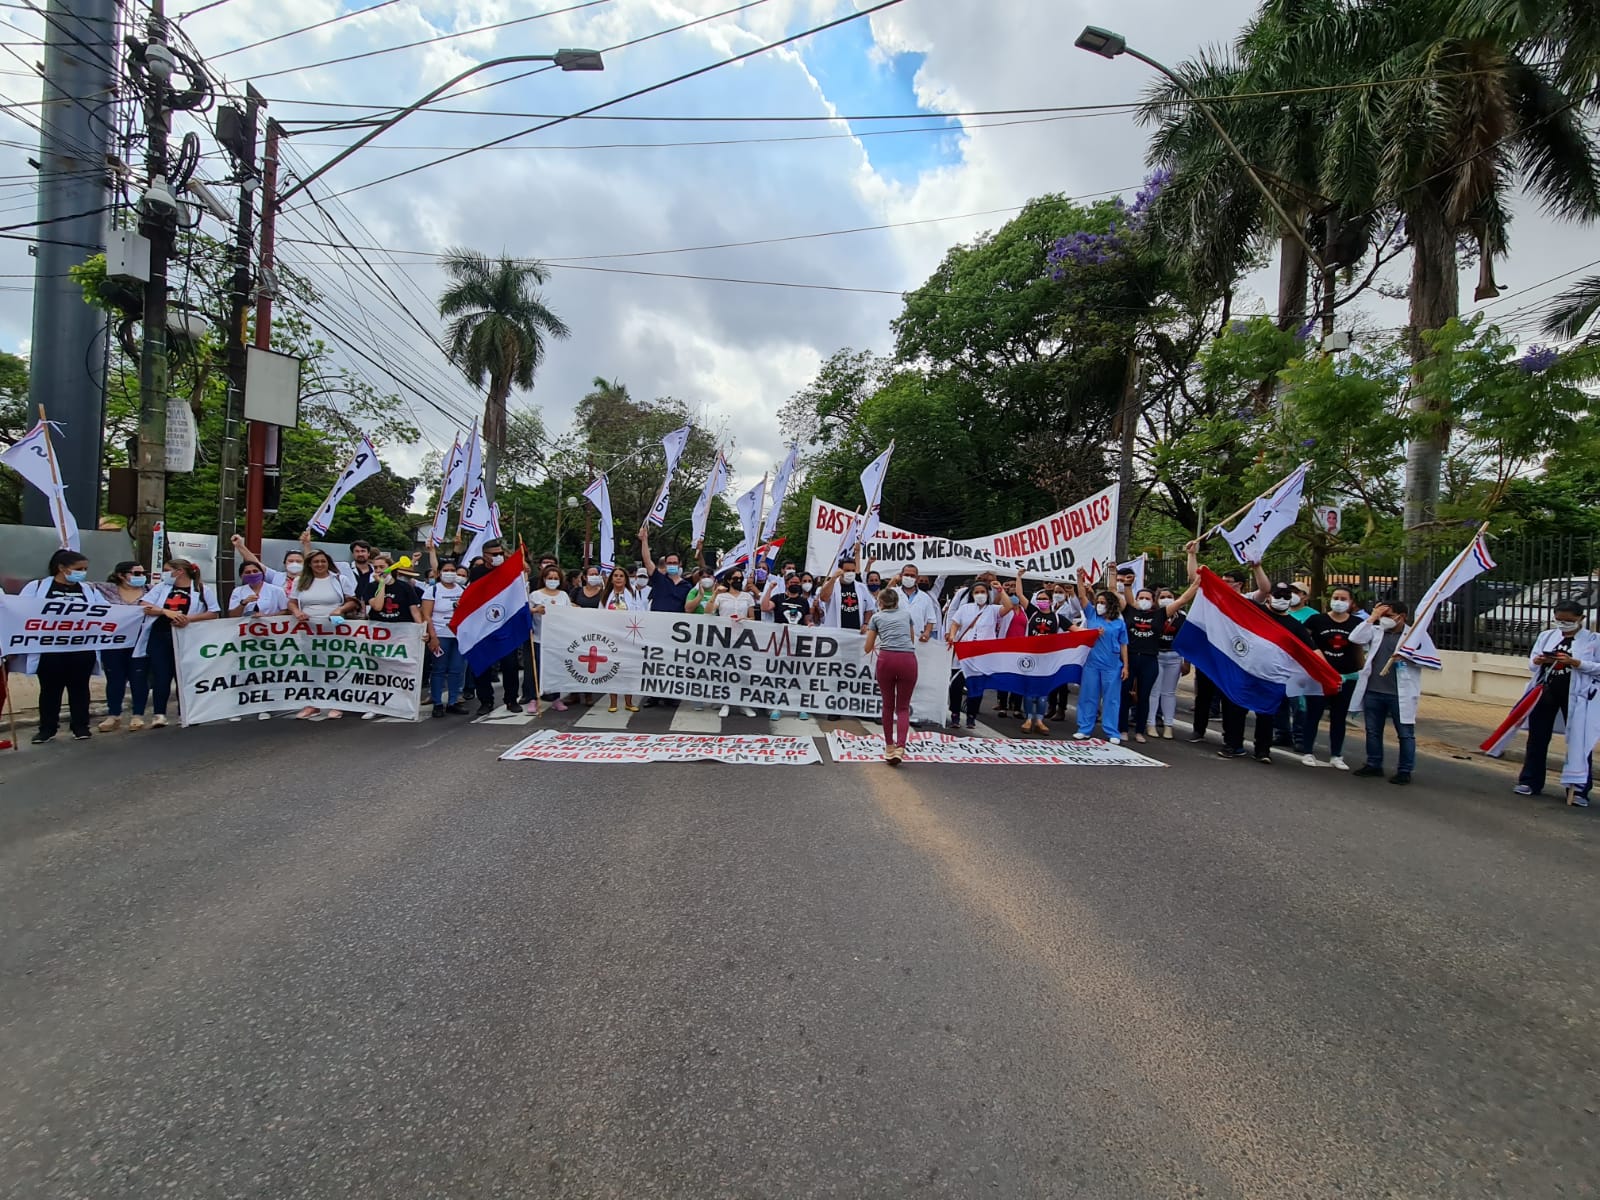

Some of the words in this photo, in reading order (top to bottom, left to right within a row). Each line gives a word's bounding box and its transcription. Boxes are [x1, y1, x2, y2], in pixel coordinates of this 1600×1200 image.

[816, 505, 861, 535] BAST
[994, 524, 1050, 558] DINERO
[1050, 494, 1110, 546] PÚBLICO
[860, 541, 916, 561] IGIMOS
[922, 539, 992, 563] MEJORAS
[995, 559, 1011, 569] EN
[1015, 547, 1075, 572] SALUD
[41, 602, 112, 617] APS
[25, 619, 117, 632] Guaira
[238, 621, 392, 641] IGUALDAD
[200, 637, 299, 659] CARGA
[313, 638, 409, 659] HORARIA
[567, 639, 580, 654] CHE
[671, 621, 839, 658] SINAMED
[239, 653, 379, 671] IGUALDAD
[564, 659, 589, 684] SINAMED
[641, 645, 664, 660] 12
[674, 648, 752, 671] HORAS
[765, 658, 877, 680] UNIVERSA
[195, 670, 314, 694] SALARIAL
[642, 661, 741, 683] NECESARIO
[750, 674, 801, 690] PARA
[809, 678, 830, 692] EL
[837, 680, 883, 697] PUEB
[238, 690, 275, 706] DEL
[284, 687, 394, 706] PARAGUAY
[640, 677, 731, 700] INVISIBLES
[740, 687, 790, 706] PARA
[800, 693, 820, 709] EL
